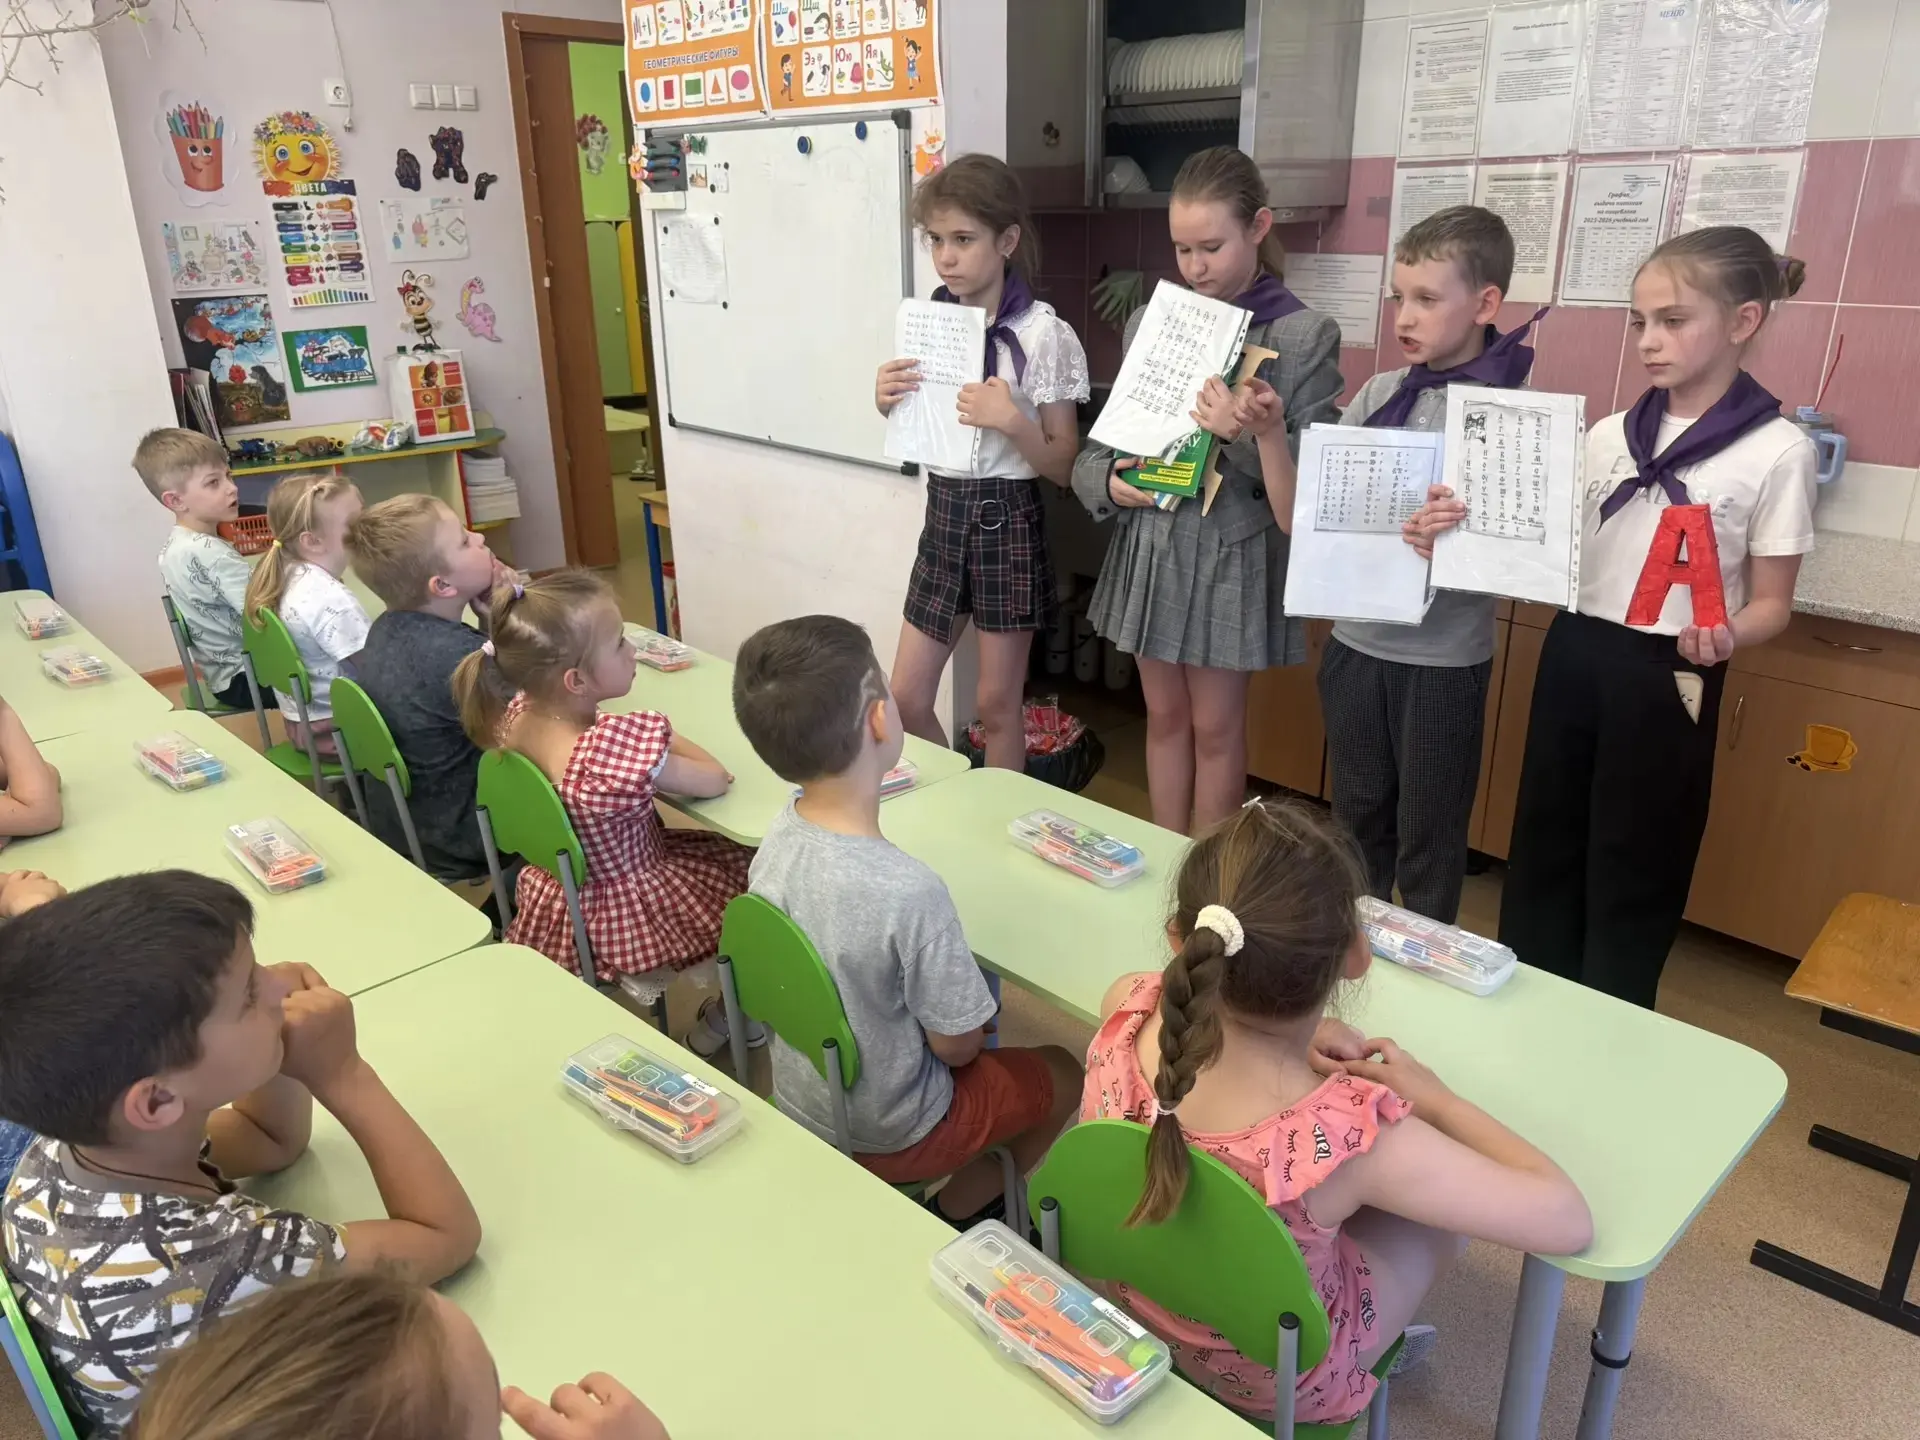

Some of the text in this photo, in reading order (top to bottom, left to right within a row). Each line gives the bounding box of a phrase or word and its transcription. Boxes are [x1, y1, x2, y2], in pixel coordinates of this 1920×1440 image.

[643, 46, 739, 70] ГЕОМЕТРИЧЕСКИЕ ФИГУРЫ
[294, 182, 328, 193] ЦВЕТА
